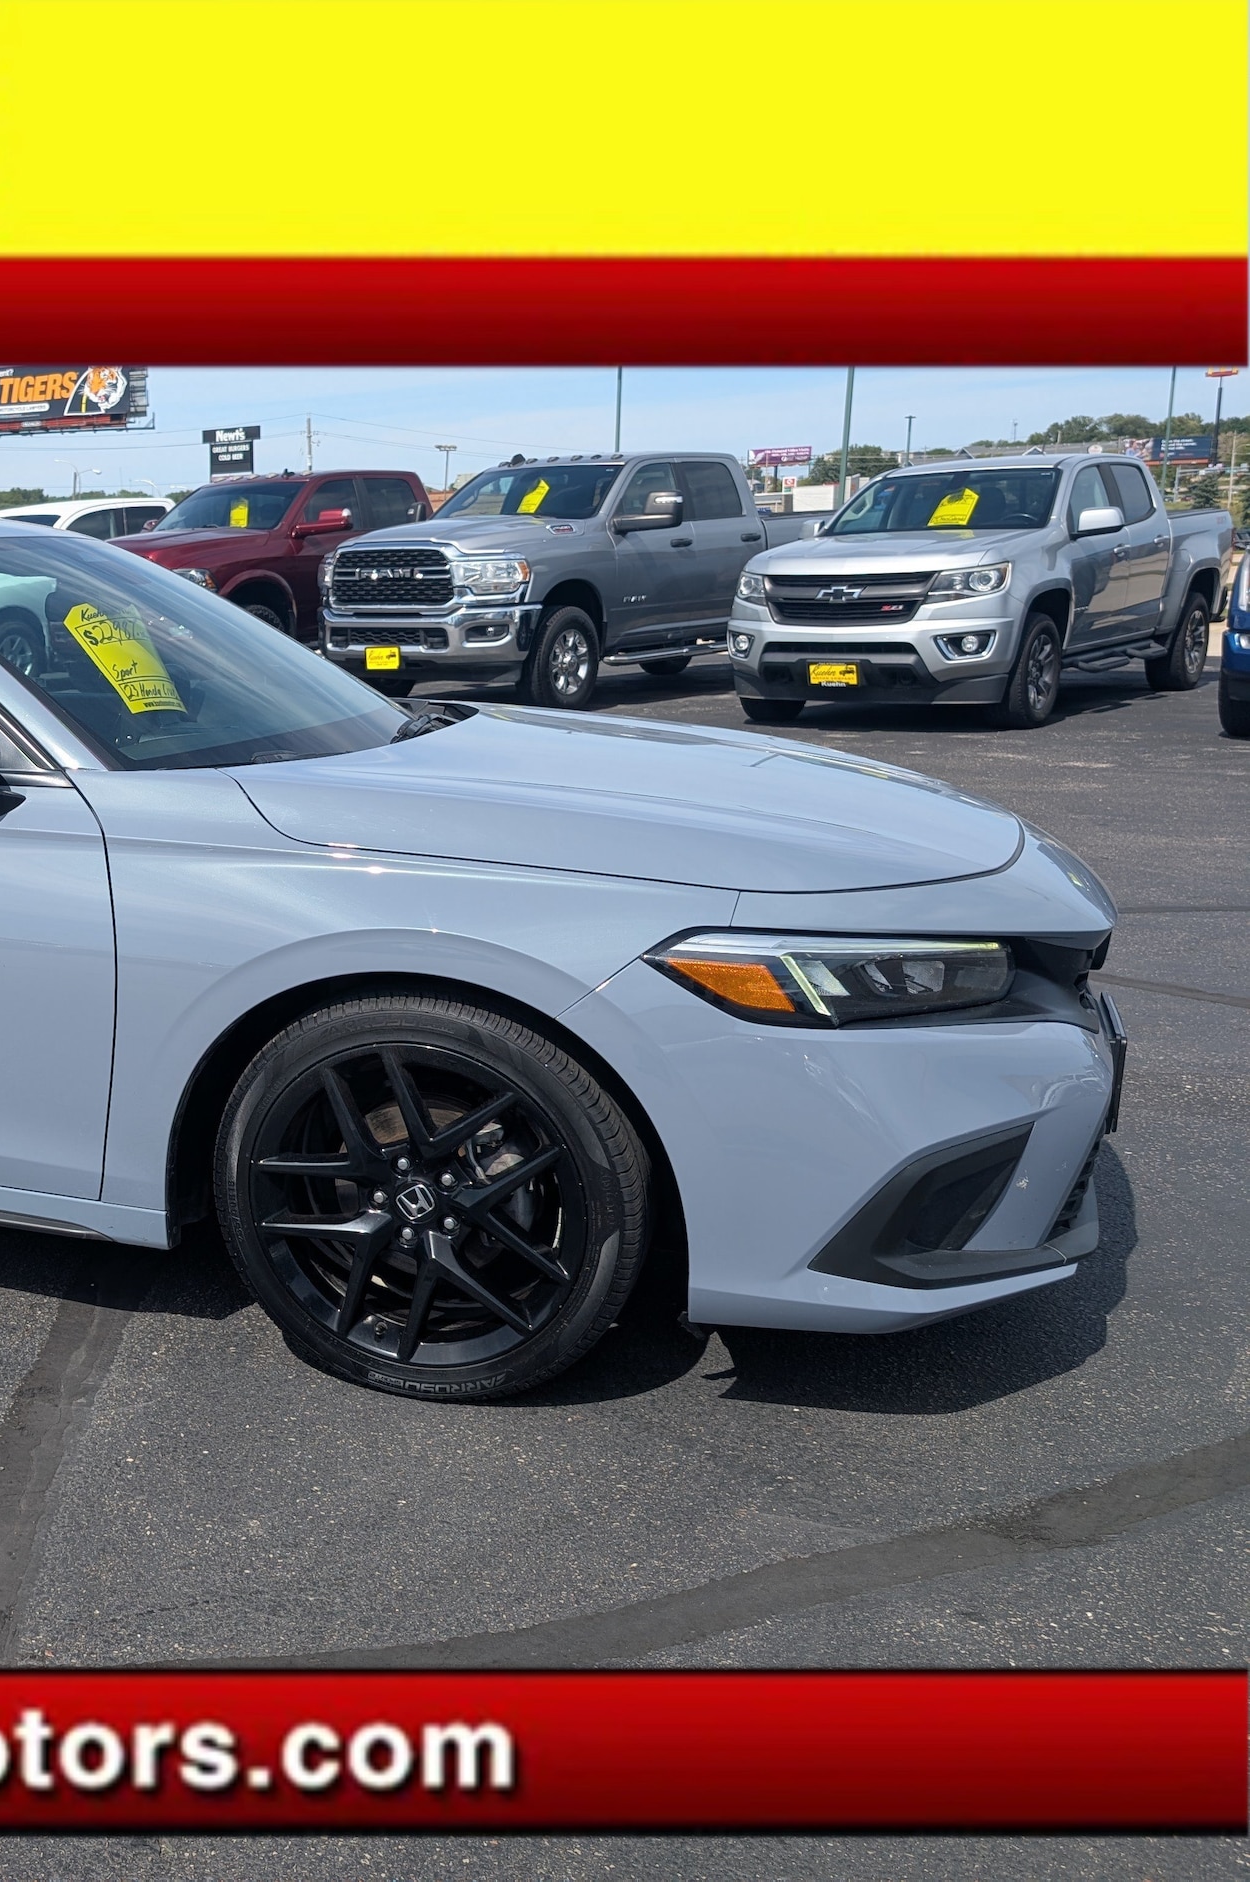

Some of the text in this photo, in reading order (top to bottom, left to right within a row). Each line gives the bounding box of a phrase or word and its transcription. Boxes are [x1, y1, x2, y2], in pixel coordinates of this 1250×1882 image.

[0, 371, 78, 404] TIGERS
[215, 428, 246, 442] Newt's
[112, 660, 138, 682] Sport
